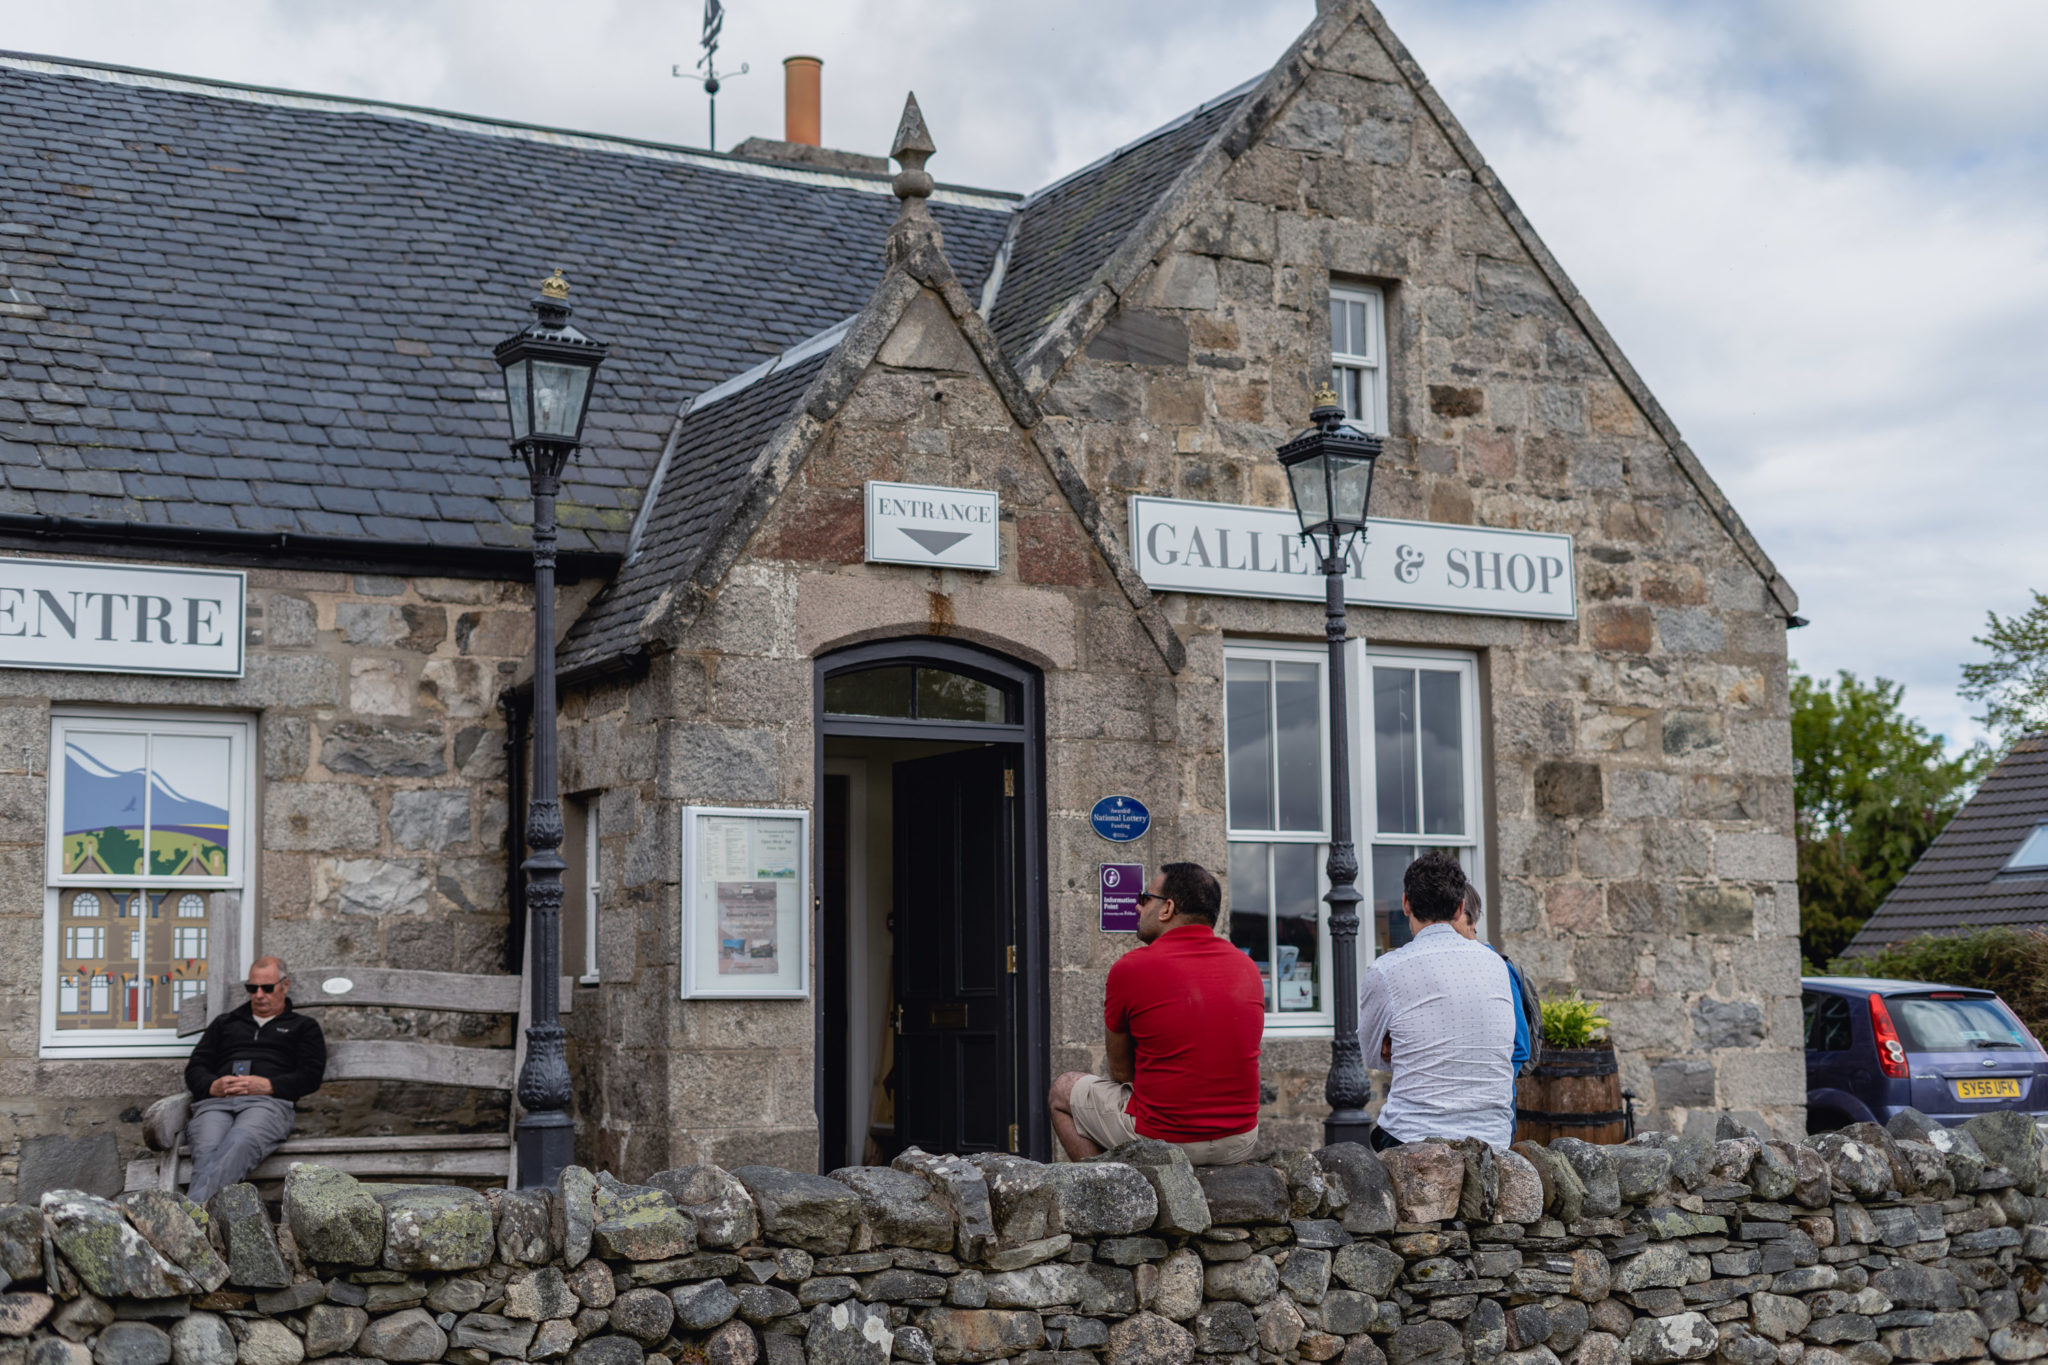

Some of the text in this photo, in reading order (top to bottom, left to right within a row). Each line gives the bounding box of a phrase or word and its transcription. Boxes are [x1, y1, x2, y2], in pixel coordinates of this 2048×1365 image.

[878, 497, 992, 524] ENTRANCE
[1394, 544, 1425, 584] &
[1446, 548, 1564, 595] SHOP
[0, 587, 224, 647] ENTRE
[1093, 813, 1149, 824] National Lottery
[1103, 896, 1137, 904] Information
[1961, 1080, 2016, 1096] SY56 UFK
